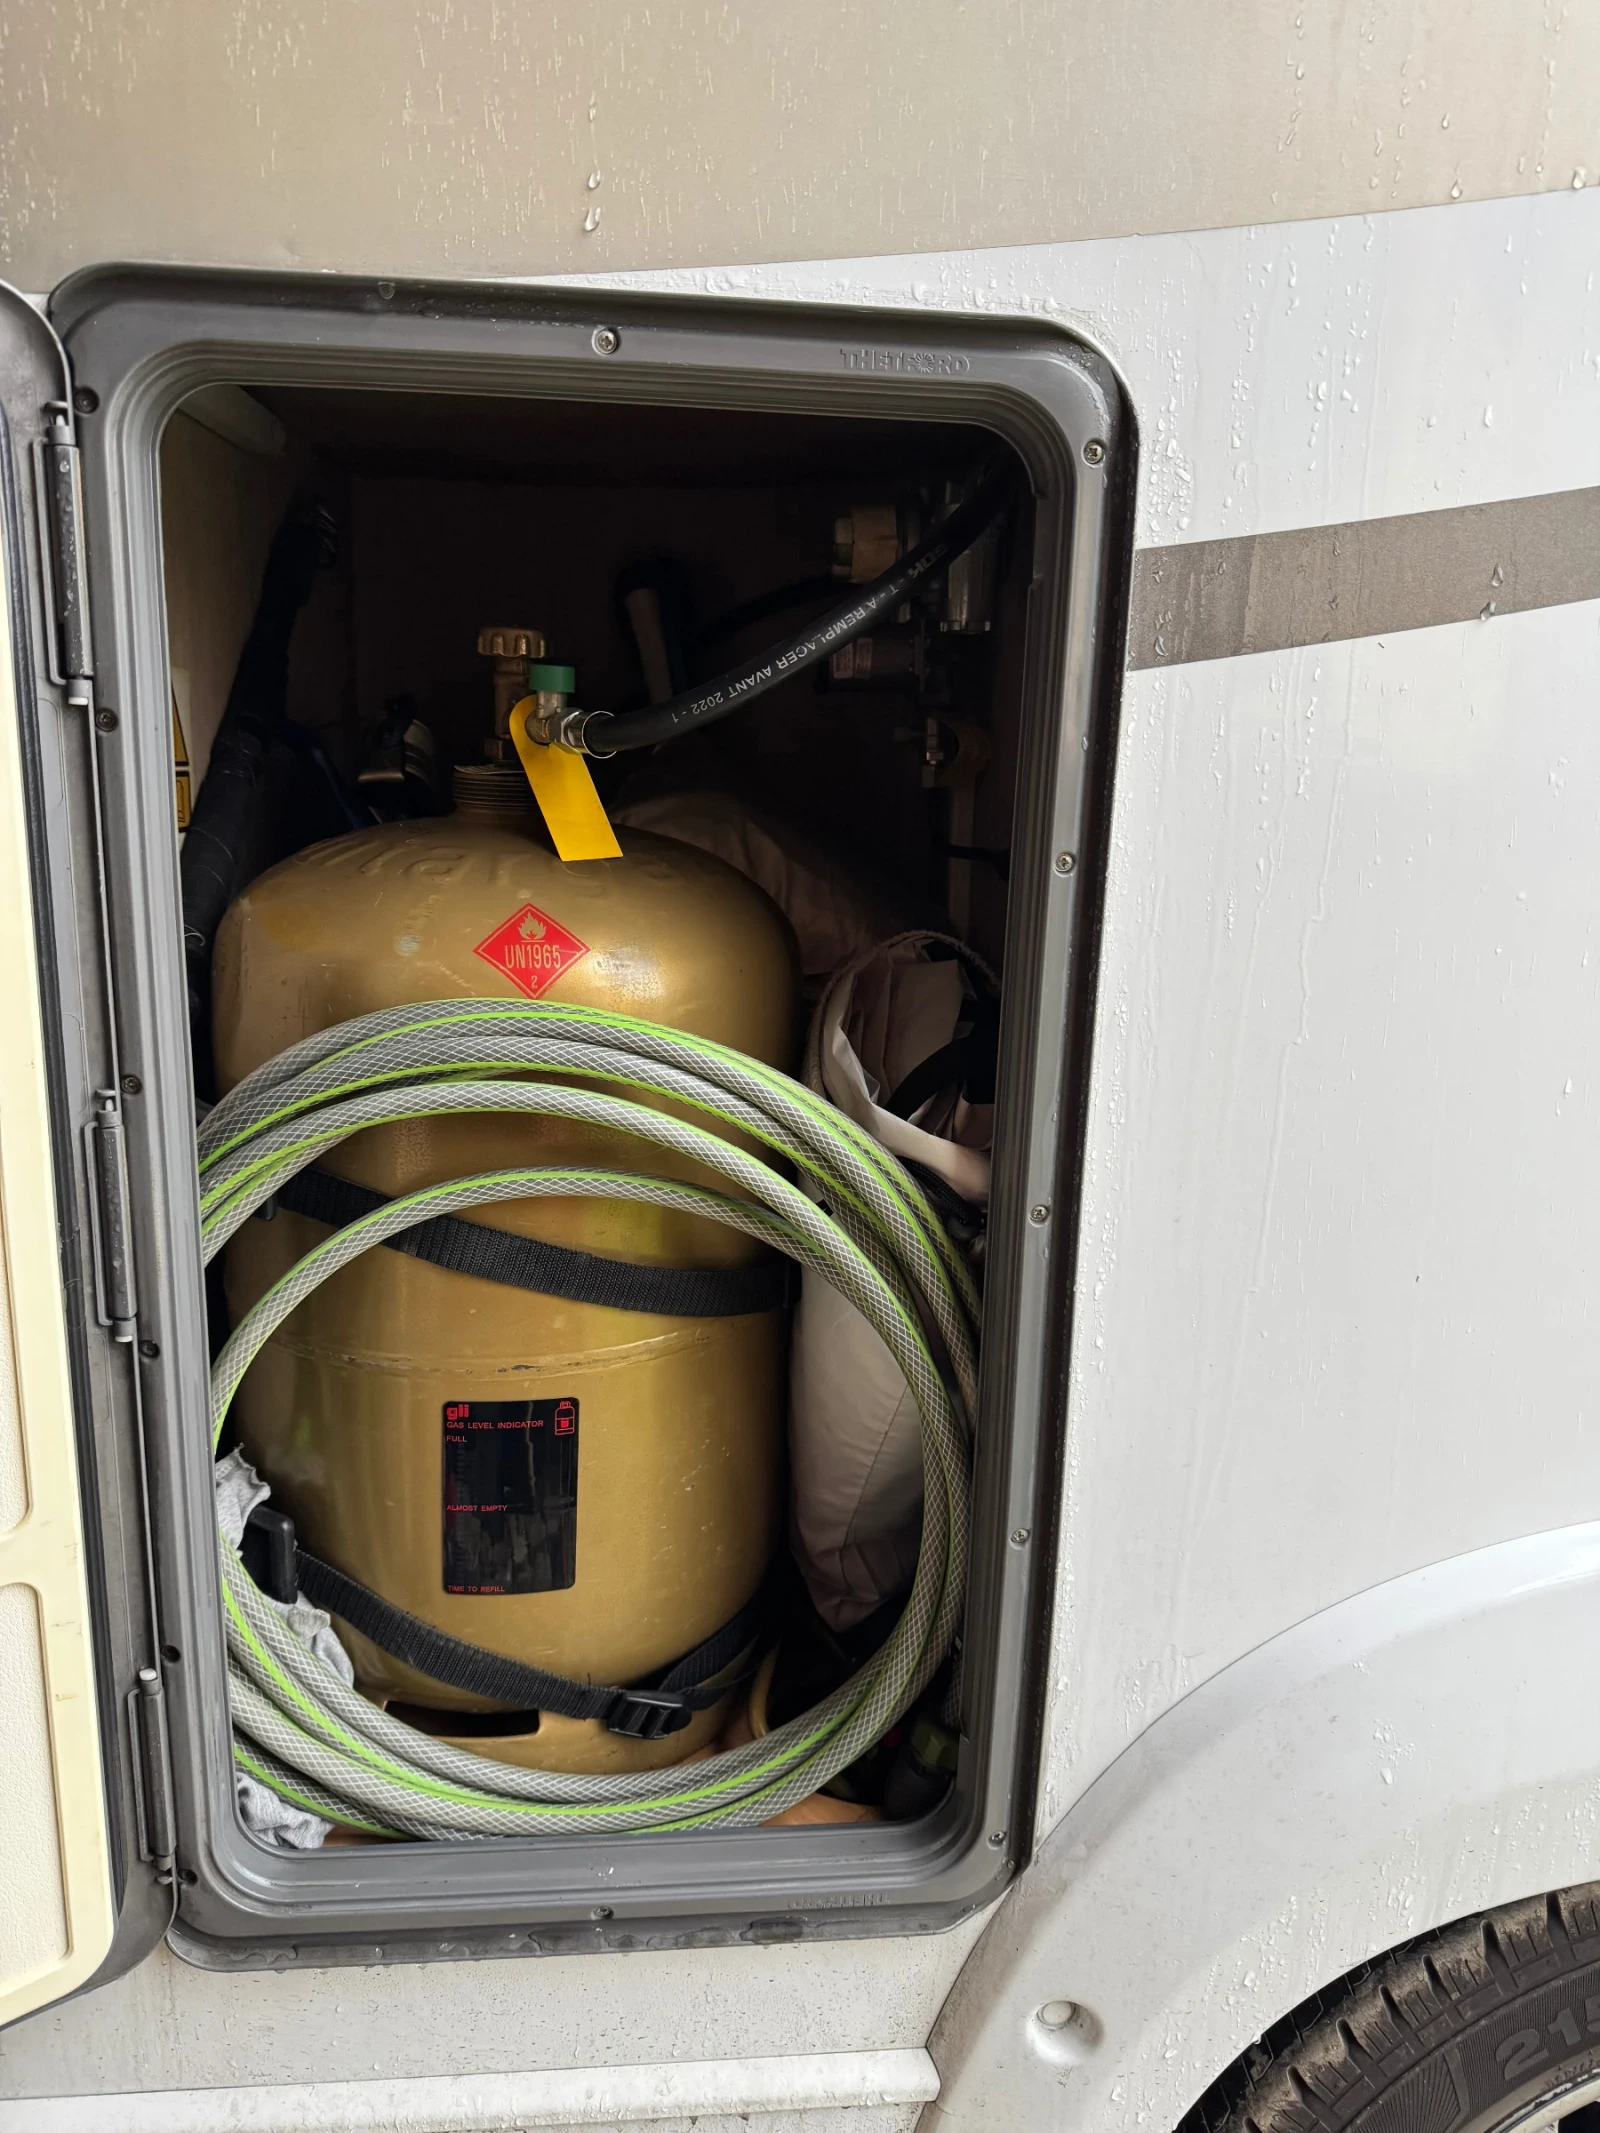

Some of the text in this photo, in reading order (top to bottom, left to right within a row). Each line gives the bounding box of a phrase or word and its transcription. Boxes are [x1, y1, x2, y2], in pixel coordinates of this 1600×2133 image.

[840, 348, 971, 374] THETFORD
[866, 597, 877, 609] A
[775, 606, 867, 669] REMPLACER
[728, 665, 772, 698] AVANT
[691, 692, 724, 714] 2022
[504, 944, 561, 969] UN1965
[531, 975, 538, 989] 2
[445, 1420, 544, 1429] GAS LEVEL INDICATOR
[445, 1435, 468, 1443] FULL
[445, 1504, 508, 1512] ALMOST EMPTY
[447, 1584, 465, 1592] TIME
[479, 1585, 505, 1593] REFILL
